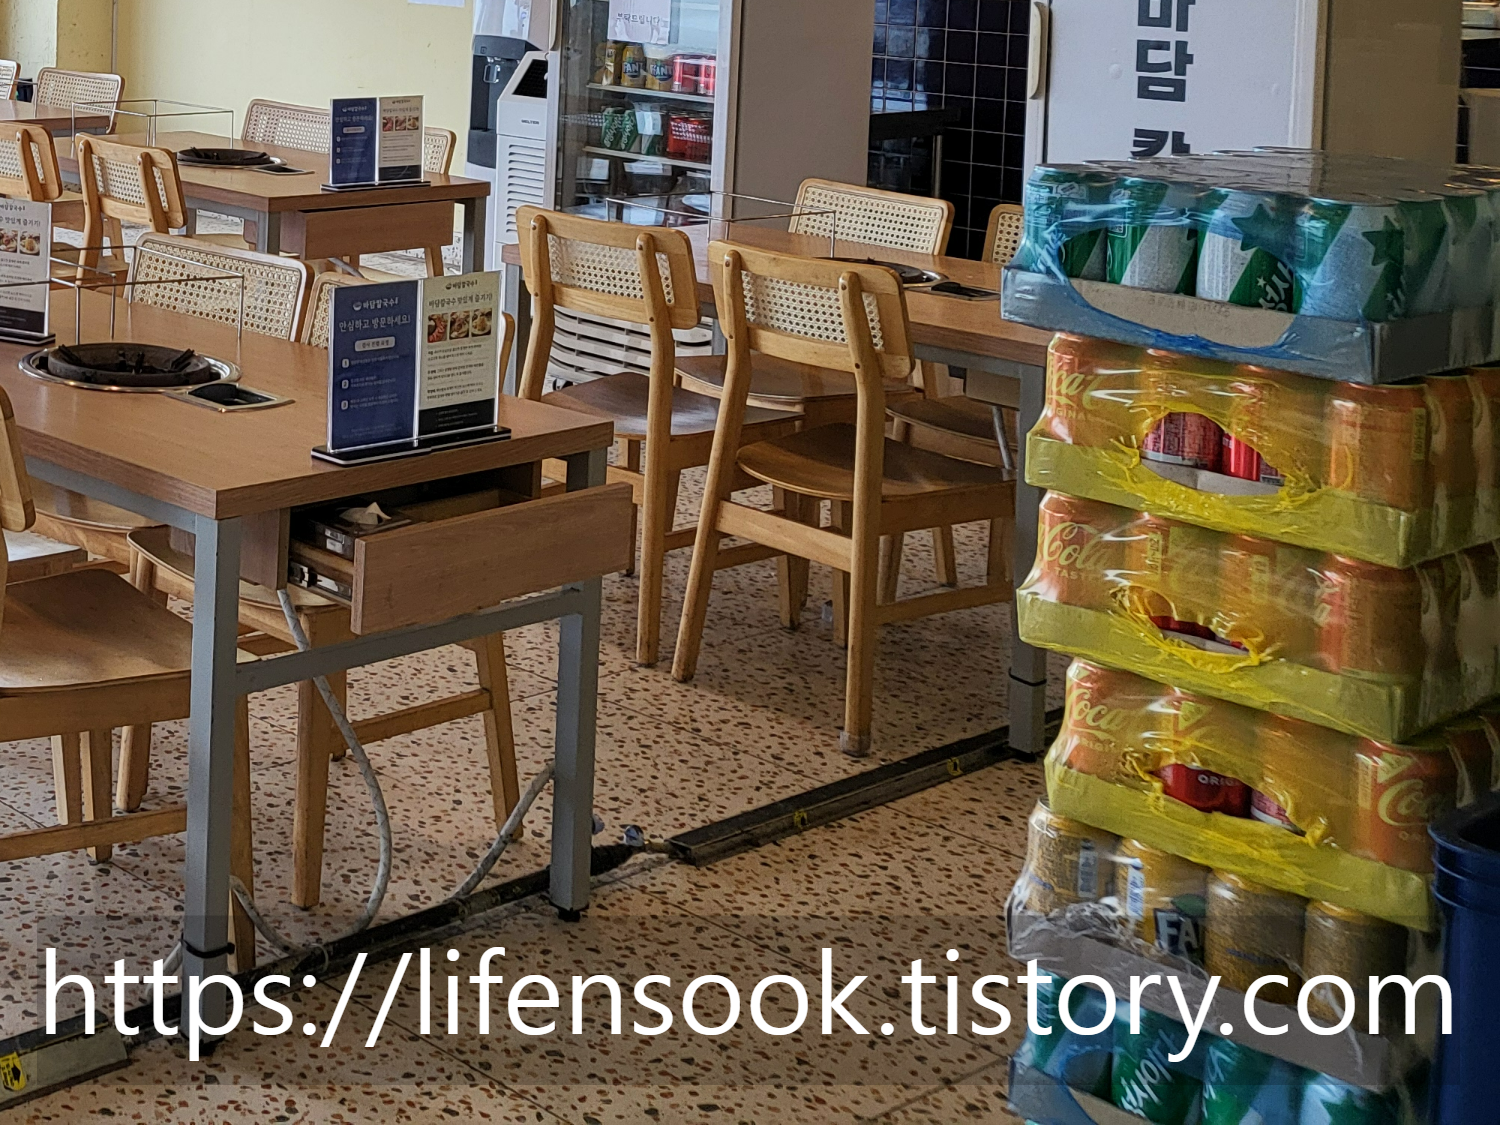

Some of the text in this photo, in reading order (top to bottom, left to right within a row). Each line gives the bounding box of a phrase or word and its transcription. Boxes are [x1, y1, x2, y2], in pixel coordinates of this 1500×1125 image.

[363, 298, 394, 310] 바담칼국수
[429, 297, 457, 308] 바담칼국수
[339, 314, 411, 333] 안심하고 방문하세요!
